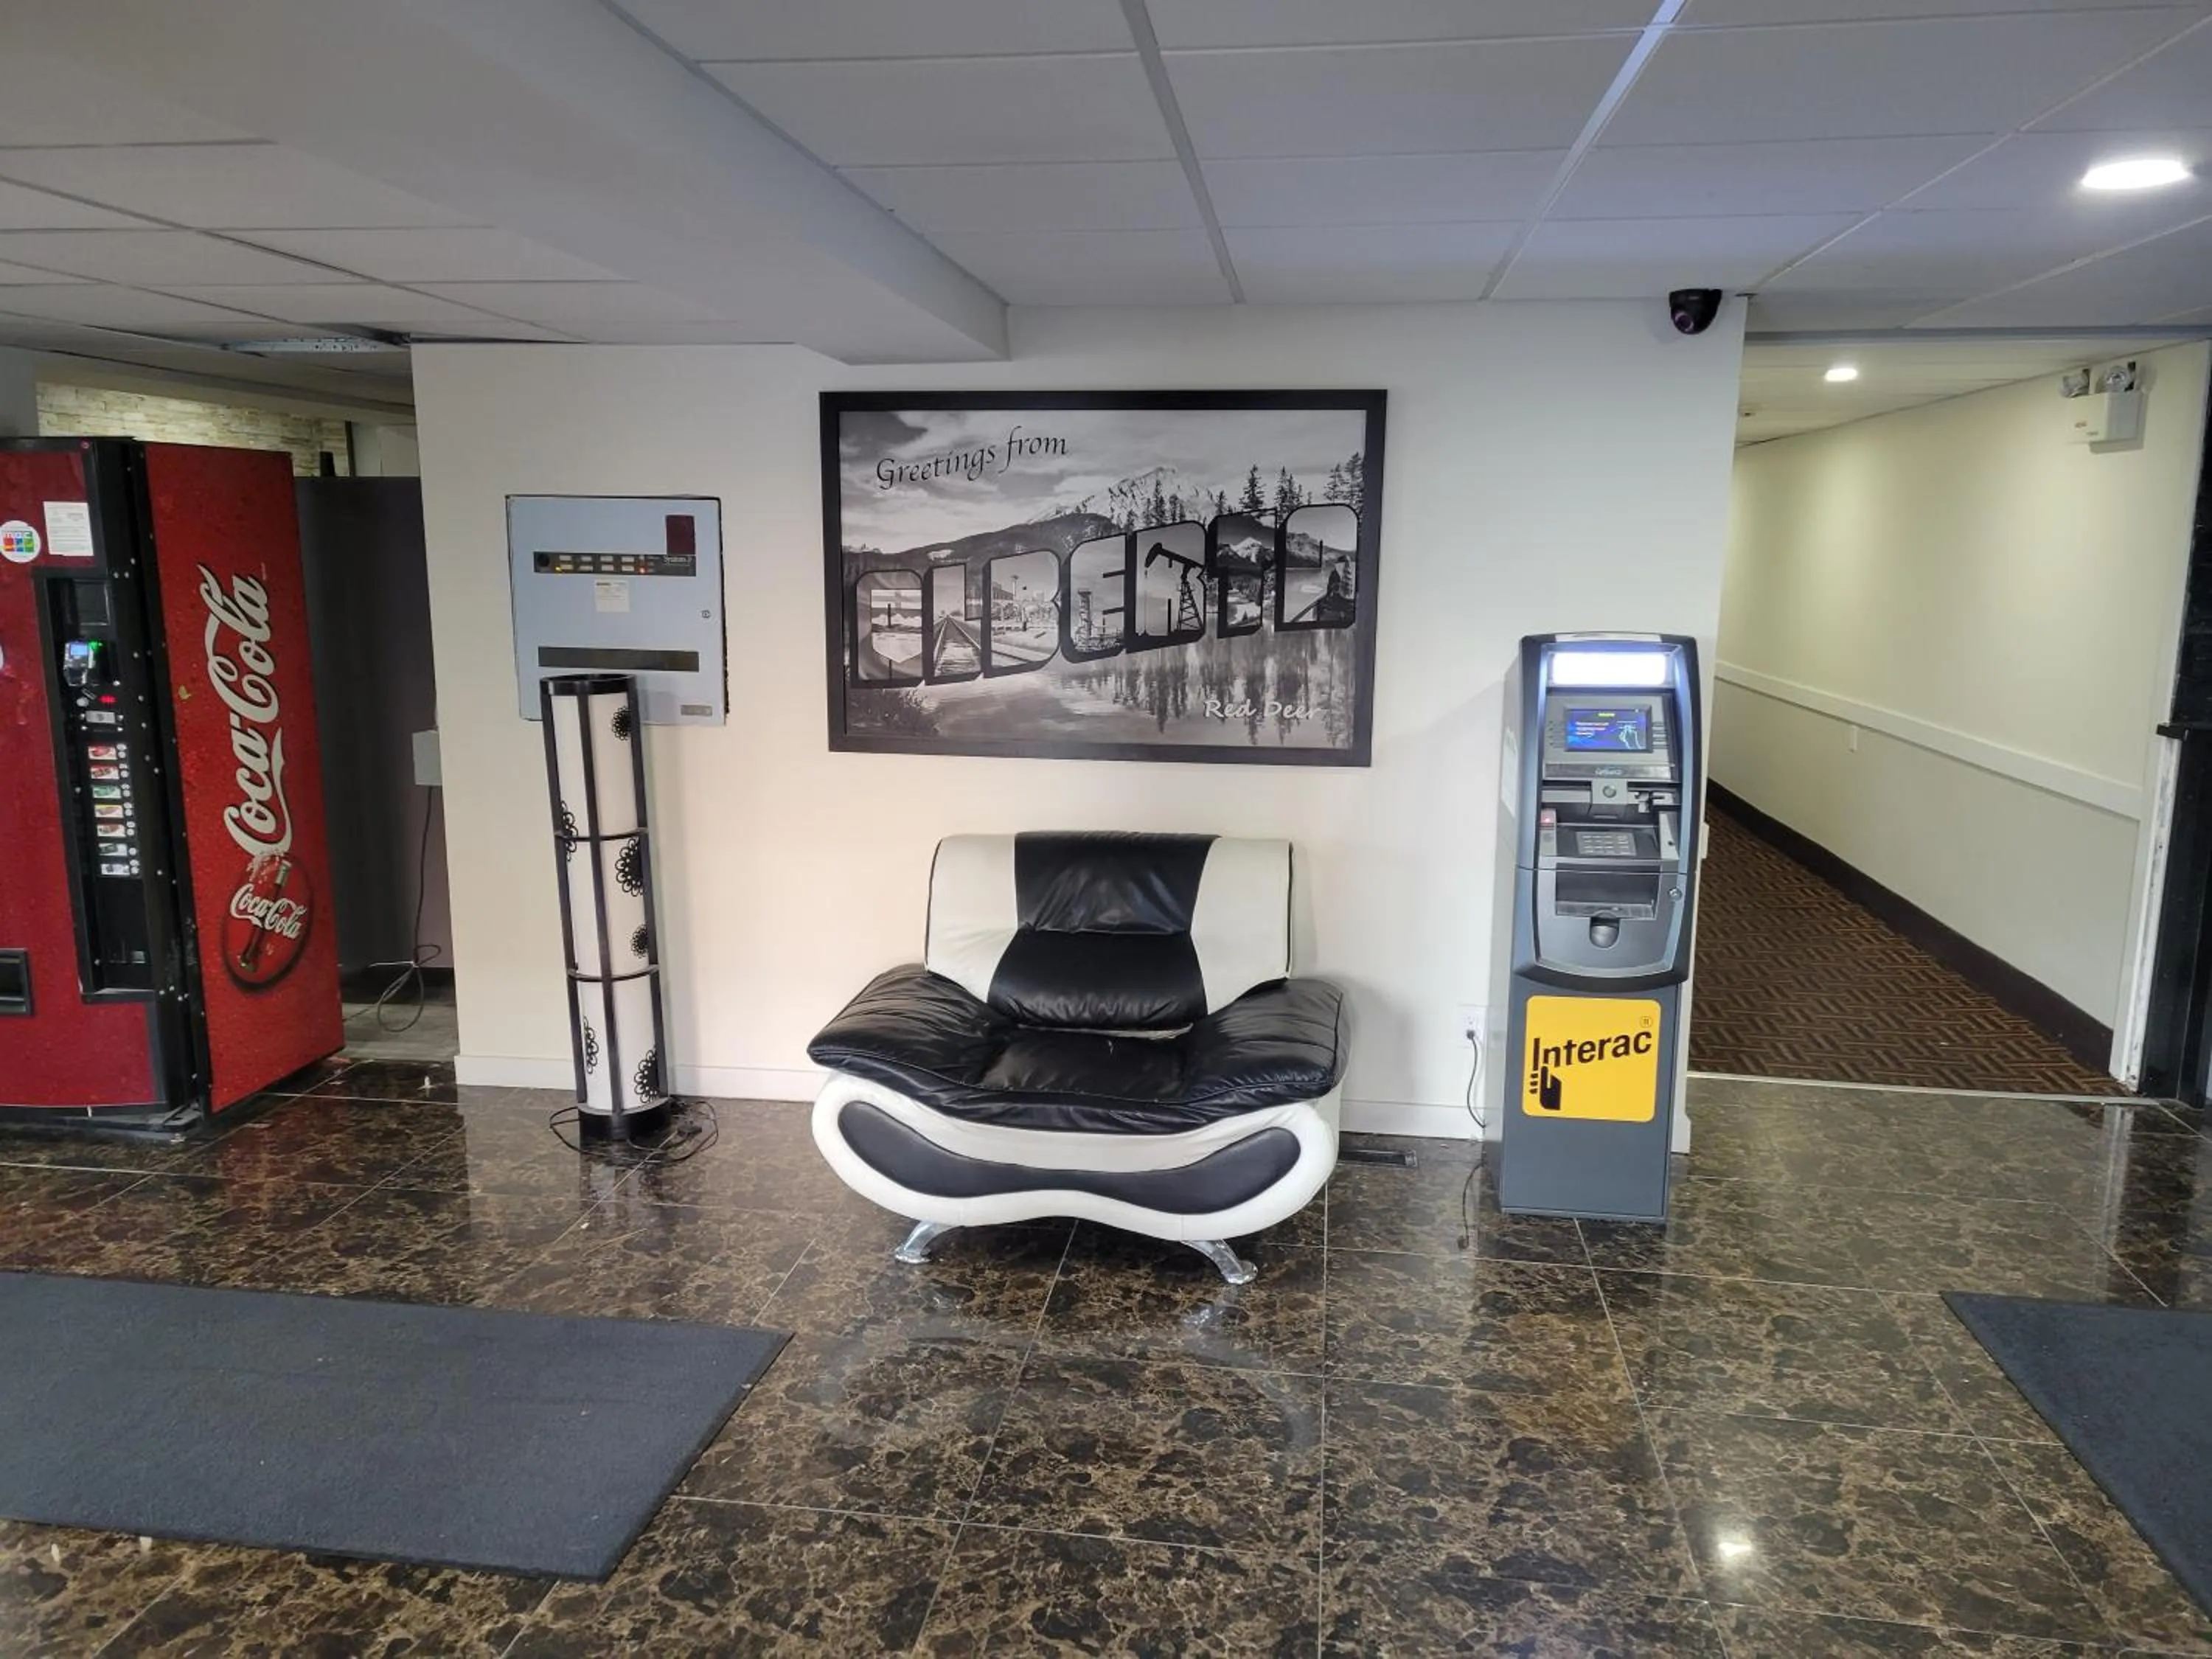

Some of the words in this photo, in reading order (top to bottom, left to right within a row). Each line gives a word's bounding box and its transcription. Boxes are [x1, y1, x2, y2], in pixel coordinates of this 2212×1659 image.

[876, 445, 997, 490] Greetings
[998, 425, 1069, 474] from
[850, 502, 1360, 689] ALBERTA
[195, 563, 293, 859] Coca-Cola
[1204, 698, 1256, 719] Red
[1264, 701, 1329, 720] Deer
[1532, 1031, 1653, 1071] Interac
